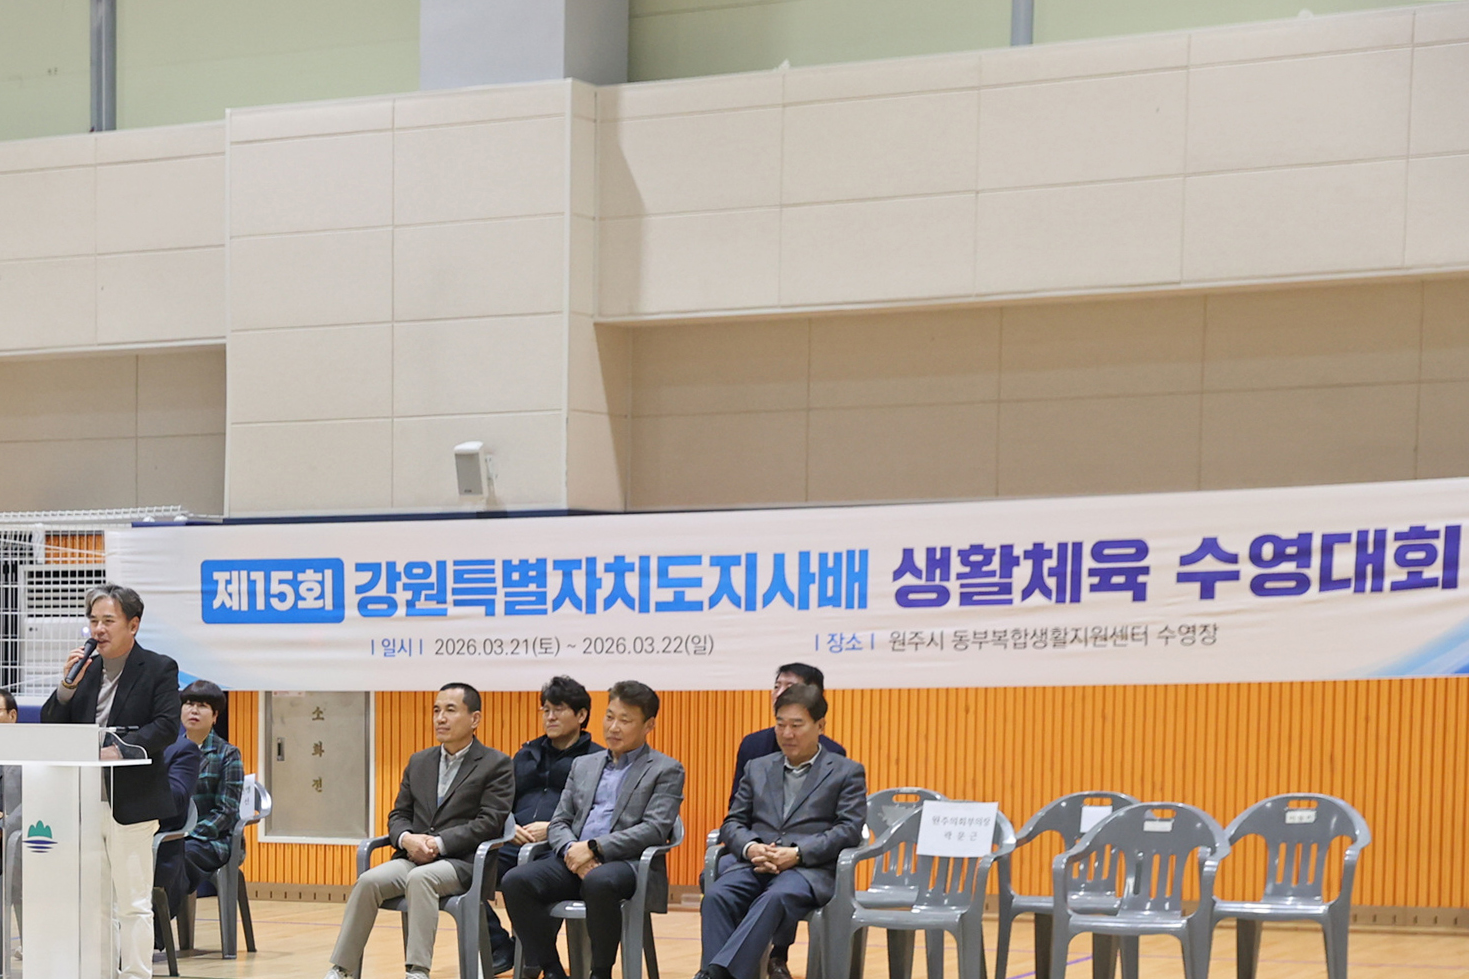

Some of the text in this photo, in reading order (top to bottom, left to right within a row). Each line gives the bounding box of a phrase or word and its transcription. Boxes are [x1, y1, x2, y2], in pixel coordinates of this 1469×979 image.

[212, 524, 1462, 618] 제15회 강원특별자치도지사배 생활체육 수영대회
[381, 637, 412, 658] 일시
[434, 636, 561, 657] 2026.03.21(토)
[582, 634, 715, 656] 2026.03.22(일)
[826, 622, 1220, 654] 장소 원주시 동부복합생활지원센터 수영장
